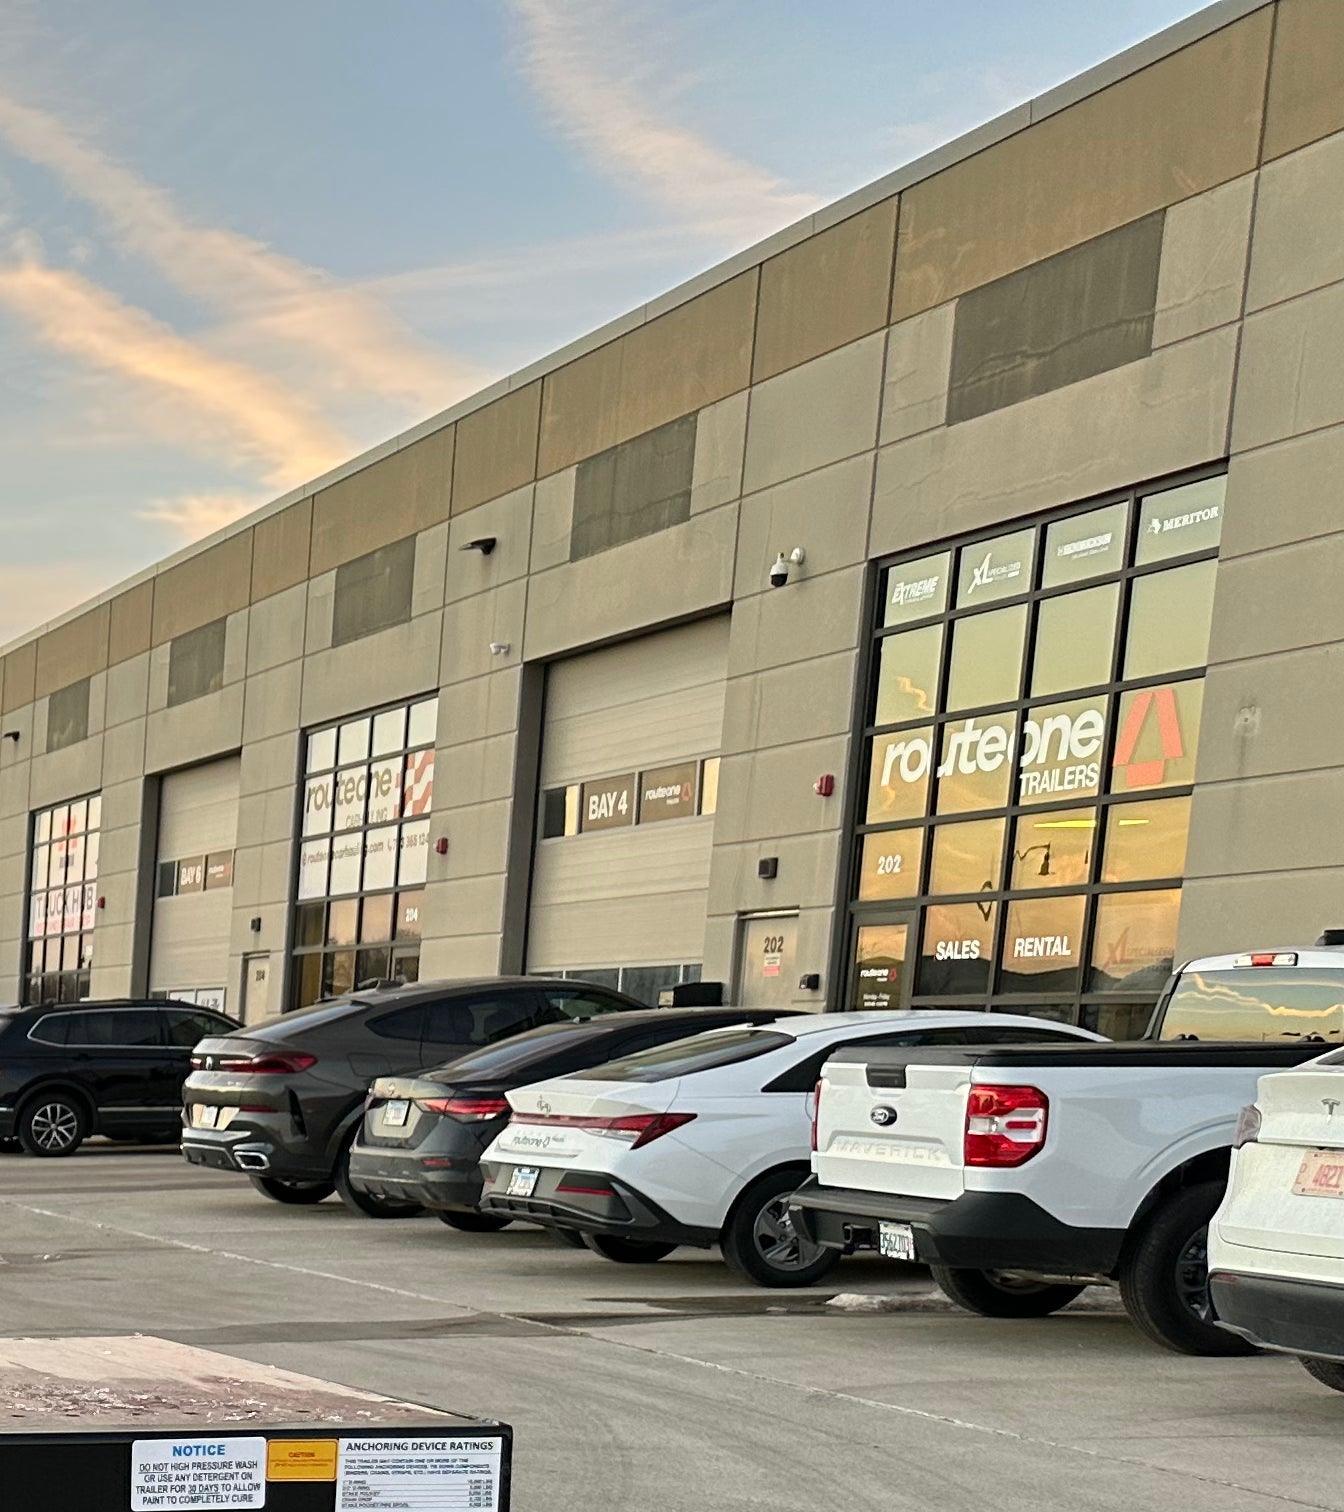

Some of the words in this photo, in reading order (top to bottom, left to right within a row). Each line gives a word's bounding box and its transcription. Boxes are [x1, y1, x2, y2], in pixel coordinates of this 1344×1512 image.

[1162, 506, 1219, 532] MERITOR
[891, 576, 939, 606] EXTREME
[880, 709, 1104, 787] routeone
[1019, 762, 1099, 797] TRAILERS
[588, 791, 618, 820] BAY
[618, 790, 628, 816] 4
[877, 854, 903, 875] 202
[36, 893, 69, 919] TUCK
[72, 887, 93, 914] HB
[763, 936, 784, 953] 202
[935, 939, 981, 961] SALES
[1013, 936, 1072, 958] RENTAL
[834, 1141, 942, 1162] MAVERICK
[172, 1444, 226, 1457] NOTICE
[346, 1442, 409, 1451] ANCHORING
[411, 1441, 447, 1451] DEVICE
[450, 1441, 494, 1451] RATINGS
[139, 1463, 150, 1472] DO
[152, 1462, 169, 1472] NOT
[170, 1462, 189, 1471] HIGH
[191, 1461, 233, 1471] PRESSURE
[235, 1460, 258, 1469] WASH
[144, 1474, 155, 1483] OR
[157, 1473, 173, 1482] USE
[174, 1473, 191, 1482] ANY
[193, 1472, 240, 1481] DETERGENT
[241, 1471, 253, 1480] ON
[136, 1485, 168, 1494] TRAILER
[170, 1484, 186, 1493] FOR
[198, 1483, 219, 1493] DAYS
[221, 1483, 232, 1492] TO
[233, 1482, 261, 1492] ALLOW
[142, 1496, 165, 1505] PAINT
[167, 1495, 177, 1504] TO
[178, 1494, 230, 1504] COMPLETELY
[231, 1493, 254, 1503] CURE
